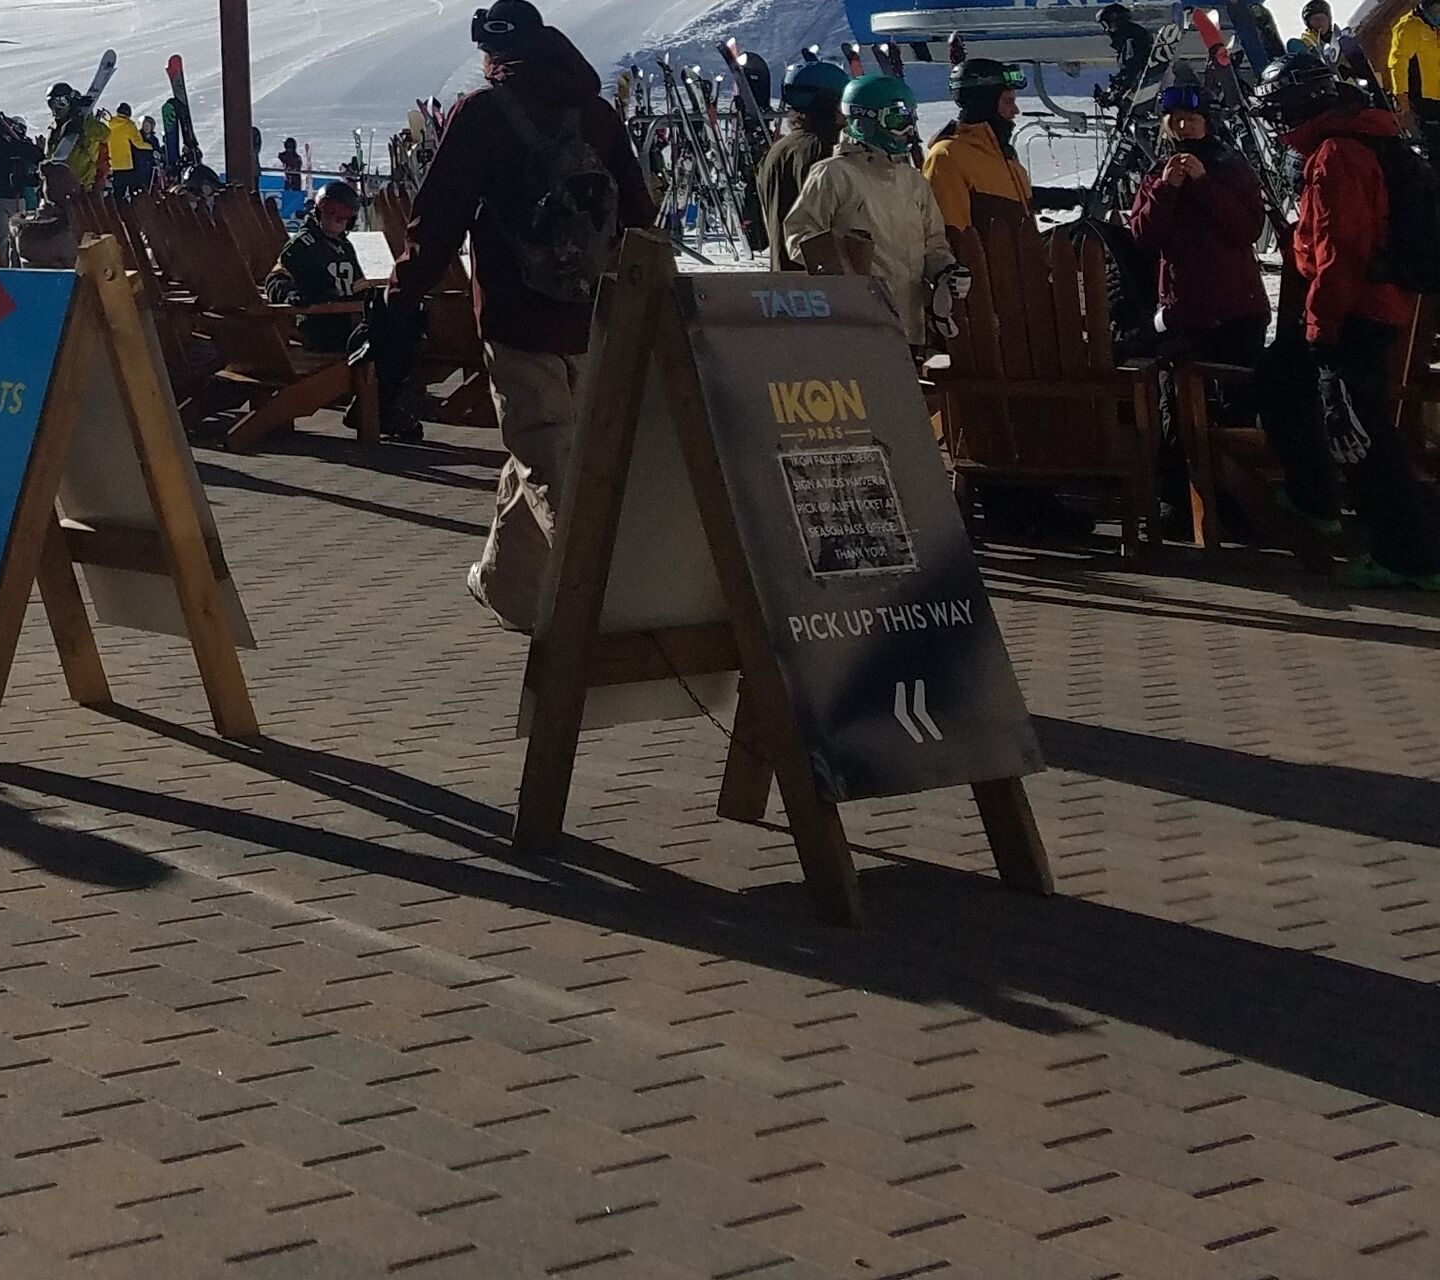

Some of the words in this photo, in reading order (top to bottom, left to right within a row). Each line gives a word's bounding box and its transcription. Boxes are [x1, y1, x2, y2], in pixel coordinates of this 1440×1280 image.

[752, 288, 832, 318] TAOS
[768, 379, 867, 424] IKON
[807, 426, 843, 441] PASS
[814, 454, 834, 466] PASS
[793, 480, 815, 491] SIGN
[816, 480, 823, 489] A
[824, 477, 845, 489] TAOS
[796, 503, 818, 514] PICK
[818, 501, 831, 512] UP
[832, 501, 839, 512] A
[807, 525, 844, 538] SEASON
[844, 523, 866, 535] PASS
[834, 547, 865, 559] THANK
[788, 611, 845, 642] PICK
[844, 608, 874, 637] UP
[876, 603, 927, 633] THIS
[926, 598, 974, 628] WAY
